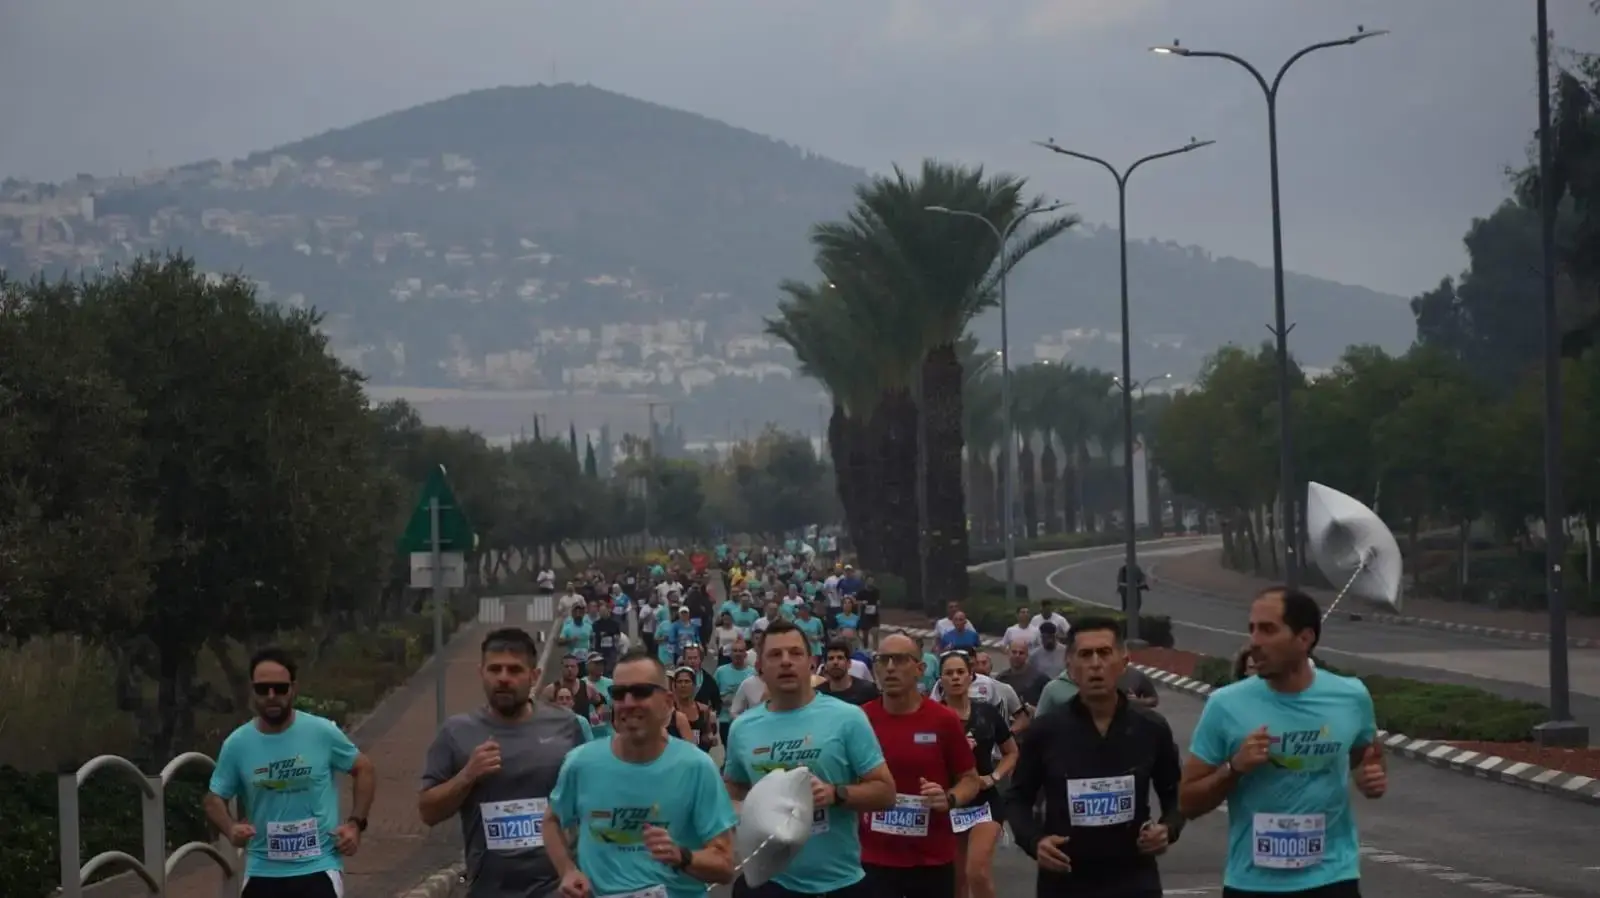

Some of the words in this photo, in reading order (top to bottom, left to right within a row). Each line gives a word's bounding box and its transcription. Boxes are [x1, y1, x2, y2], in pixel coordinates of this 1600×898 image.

[1087, 797, 1118, 816] 1274
[502, 820, 533, 838] 1210
[280, 837, 306, 852] 1172
[1273, 837, 1306, 856] 1008
